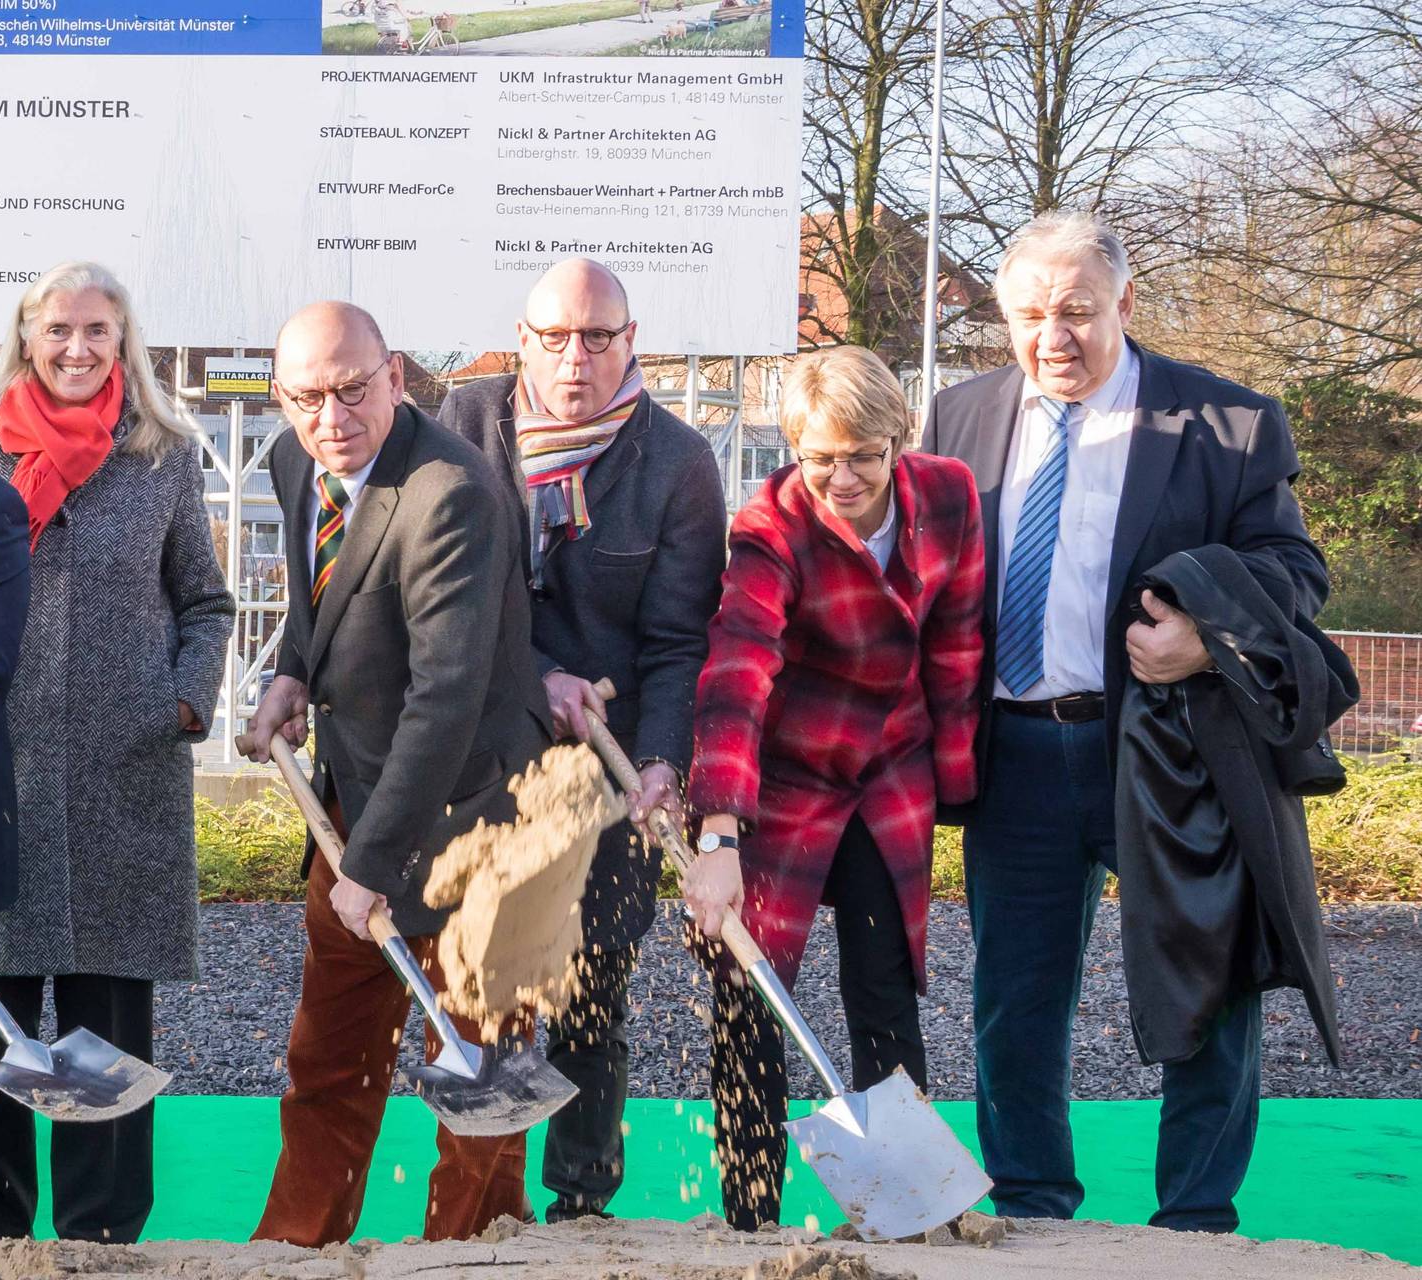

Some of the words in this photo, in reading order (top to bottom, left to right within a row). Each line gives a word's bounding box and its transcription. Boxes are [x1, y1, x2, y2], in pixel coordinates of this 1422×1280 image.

[22, 0, 57, 11] 50%)
[40, 18, 175, 32] Wilhelms-Universität
[179, 19, 235, 32] Münster
[12, 34, 52, 47] 48149
[56, 34, 111, 47] Münster
[677, 48, 706, 56] Partner
[707, 48, 752, 56] Architekten
[752, 48, 765, 56] AG
[321, 70, 478, 84] PROJEKTMANAGEMENT
[499, 71, 535, 84] UKM
[543, 71, 633, 85] Infrastruktur
[637, 72, 733, 88] Management
[737, 72, 784, 86] GmbH
[498, 90, 666, 105] Albert-Schweitzer-Campus
[671, 92, 680, 105] 1,
[684, 92, 726, 105] 48149
[729, 91, 784, 105] Münster
[17, 96, 130, 118] MÜNSTER
[319, 124, 406, 139] STÄDTEBAUL.
[409, 127, 471, 140] KONZEPT
[498, 128, 534, 140] Nickl
[538, 128, 550, 140] &
[554, 128, 606, 141] Partner
[609, 128, 690, 142] Architekten
[695, 129, 717, 142] AG
[497, 146, 580, 161] Lindberghstr.
[585, 146, 602, 160] 19,
[607, 146, 648, 160] 80939
[651, 146, 712, 160] München
[318, 182, 385, 195] ENTWURF
[389, 183, 455, 196] MedForCe
[496, 184, 594, 198] Brechensbauer
[595, 185, 654, 199] Weinhart
[657, 187, 666, 198] +
[670, 186, 717, 199] Partner
[719, 186, 749, 199] Arch
[752, 186, 785, 199] mbB
[34, 198, 125, 211] FORSCHUNG
[496, 202, 650, 218] Gustav-Heinemann-Ring
[654, 204, 678, 218] 121,
[684, 204, 724, 217] 81739
[728, 204, 788, 218] München
[317, 238, 381, 251] ENTWURF
[384, 239, 417, 251] BBIM
[495, 240, 531, 253] Nickl
[535, 240, 547, 253] &
[550, 241, 603, 254] Partner
[606, 241, 687, 255] Architekten
[690, 242, 714, 255] AG
[649, 260, 709, 274] München
[208, 372, 270, 380] MIETANLAGE
